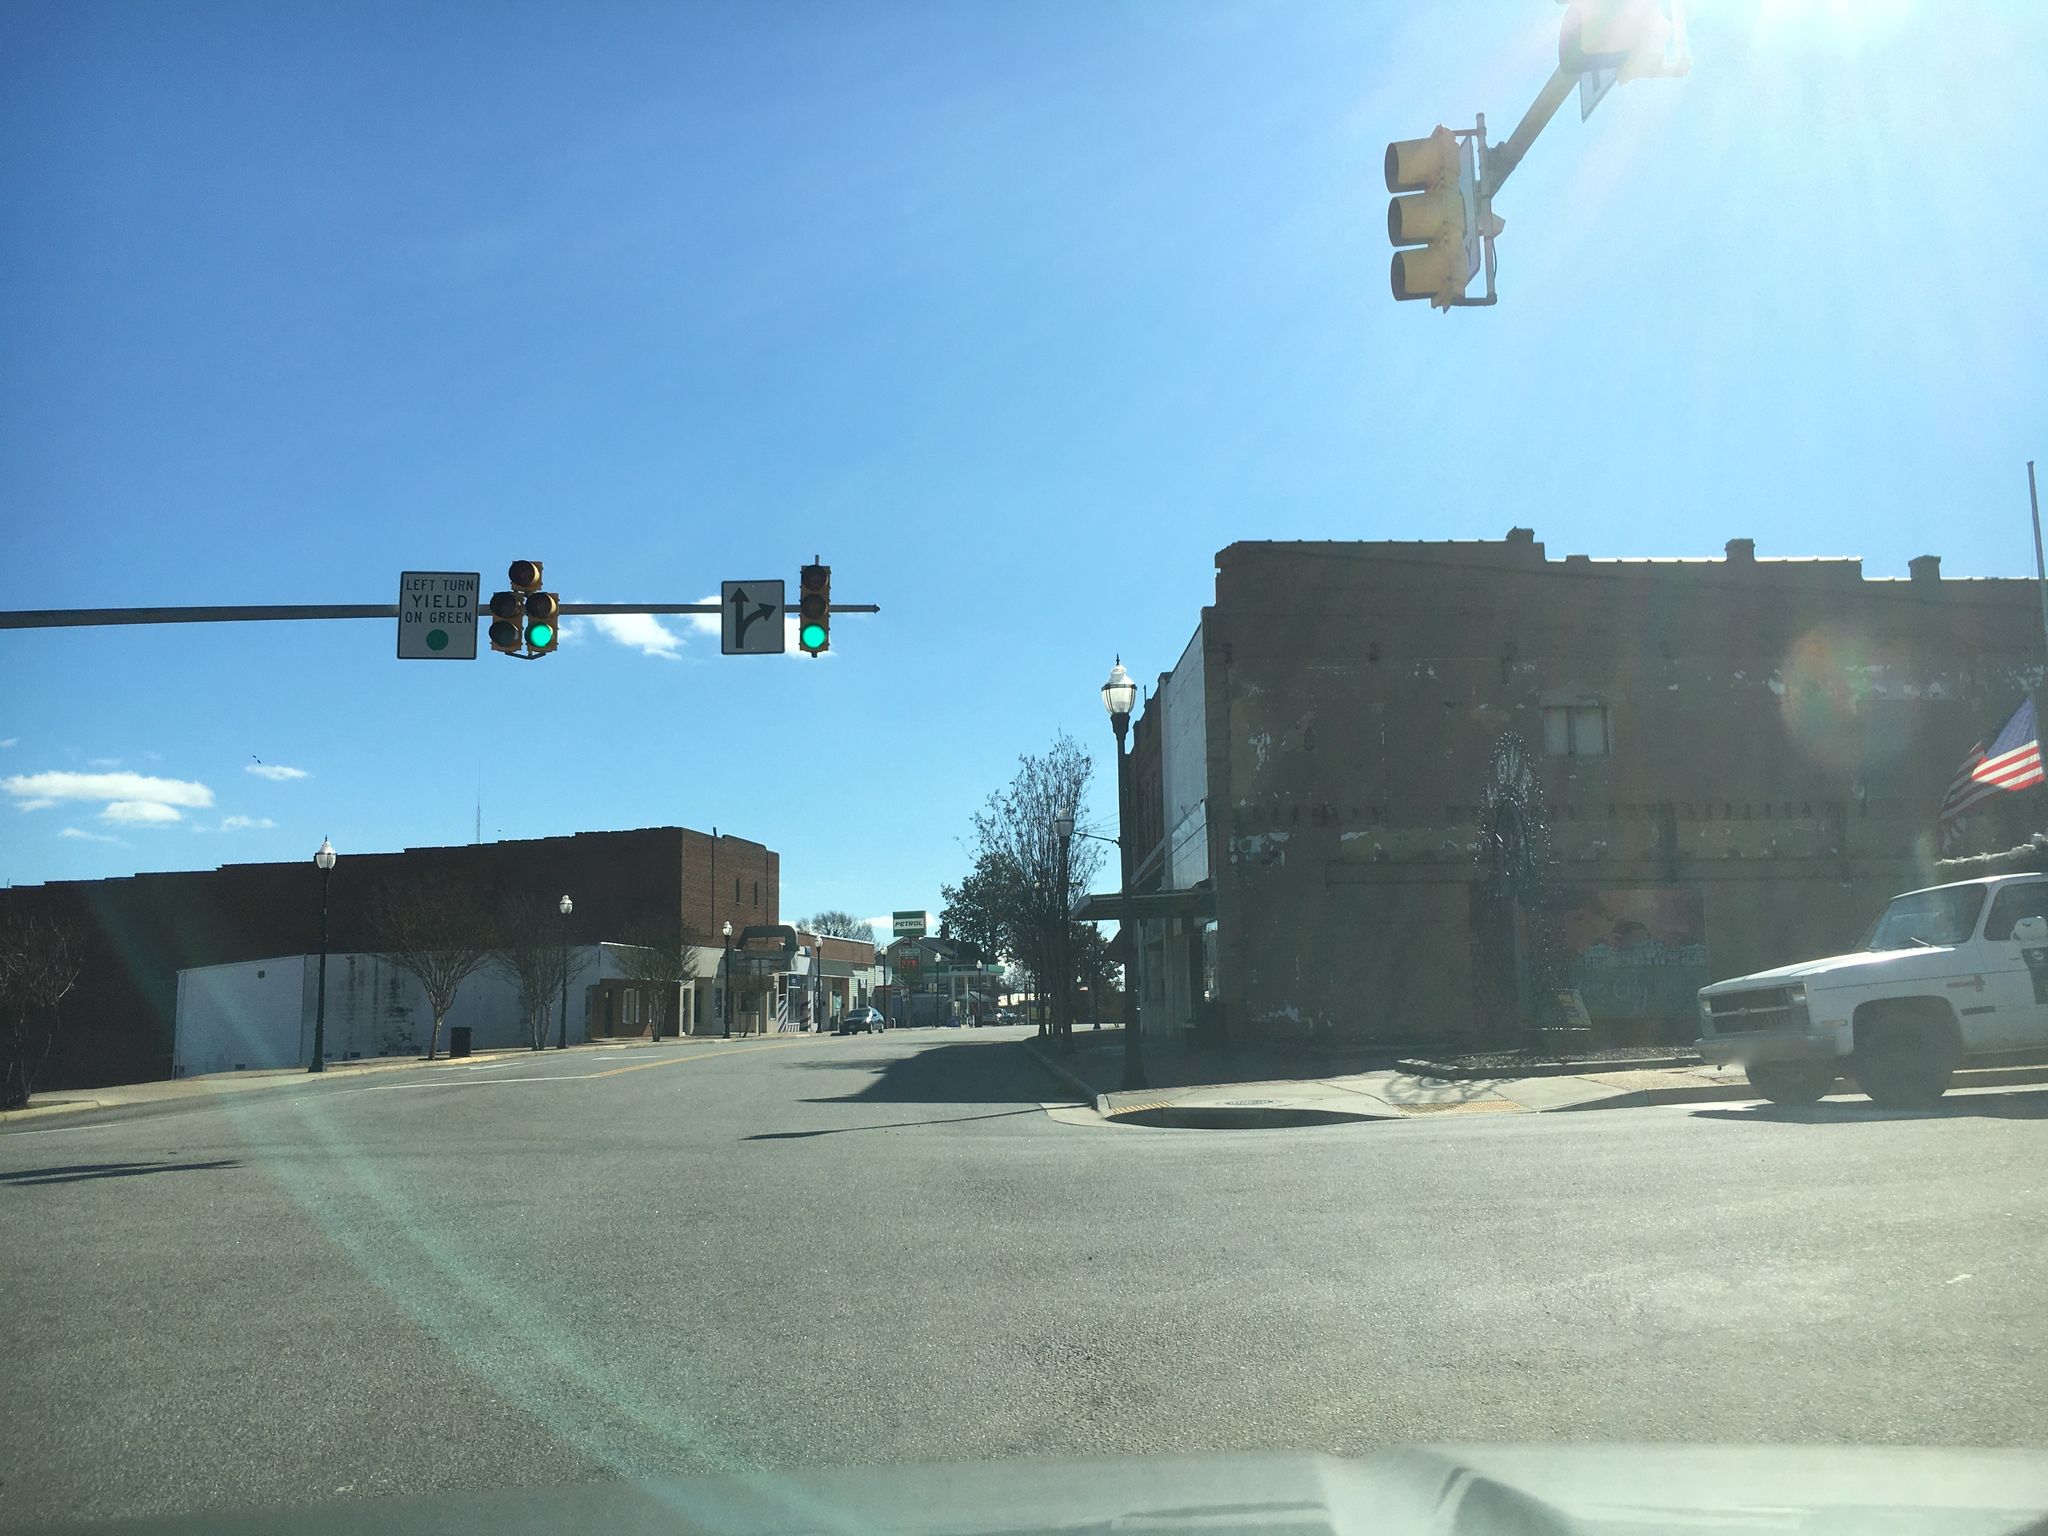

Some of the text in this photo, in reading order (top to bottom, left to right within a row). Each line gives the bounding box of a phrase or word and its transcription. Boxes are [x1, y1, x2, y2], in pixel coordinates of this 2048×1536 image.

[406, 579, 474, 592] LEFT TURN
[412, 594, 468, 608] YIELD
[405, 611, 472, 624] ON GREEN
